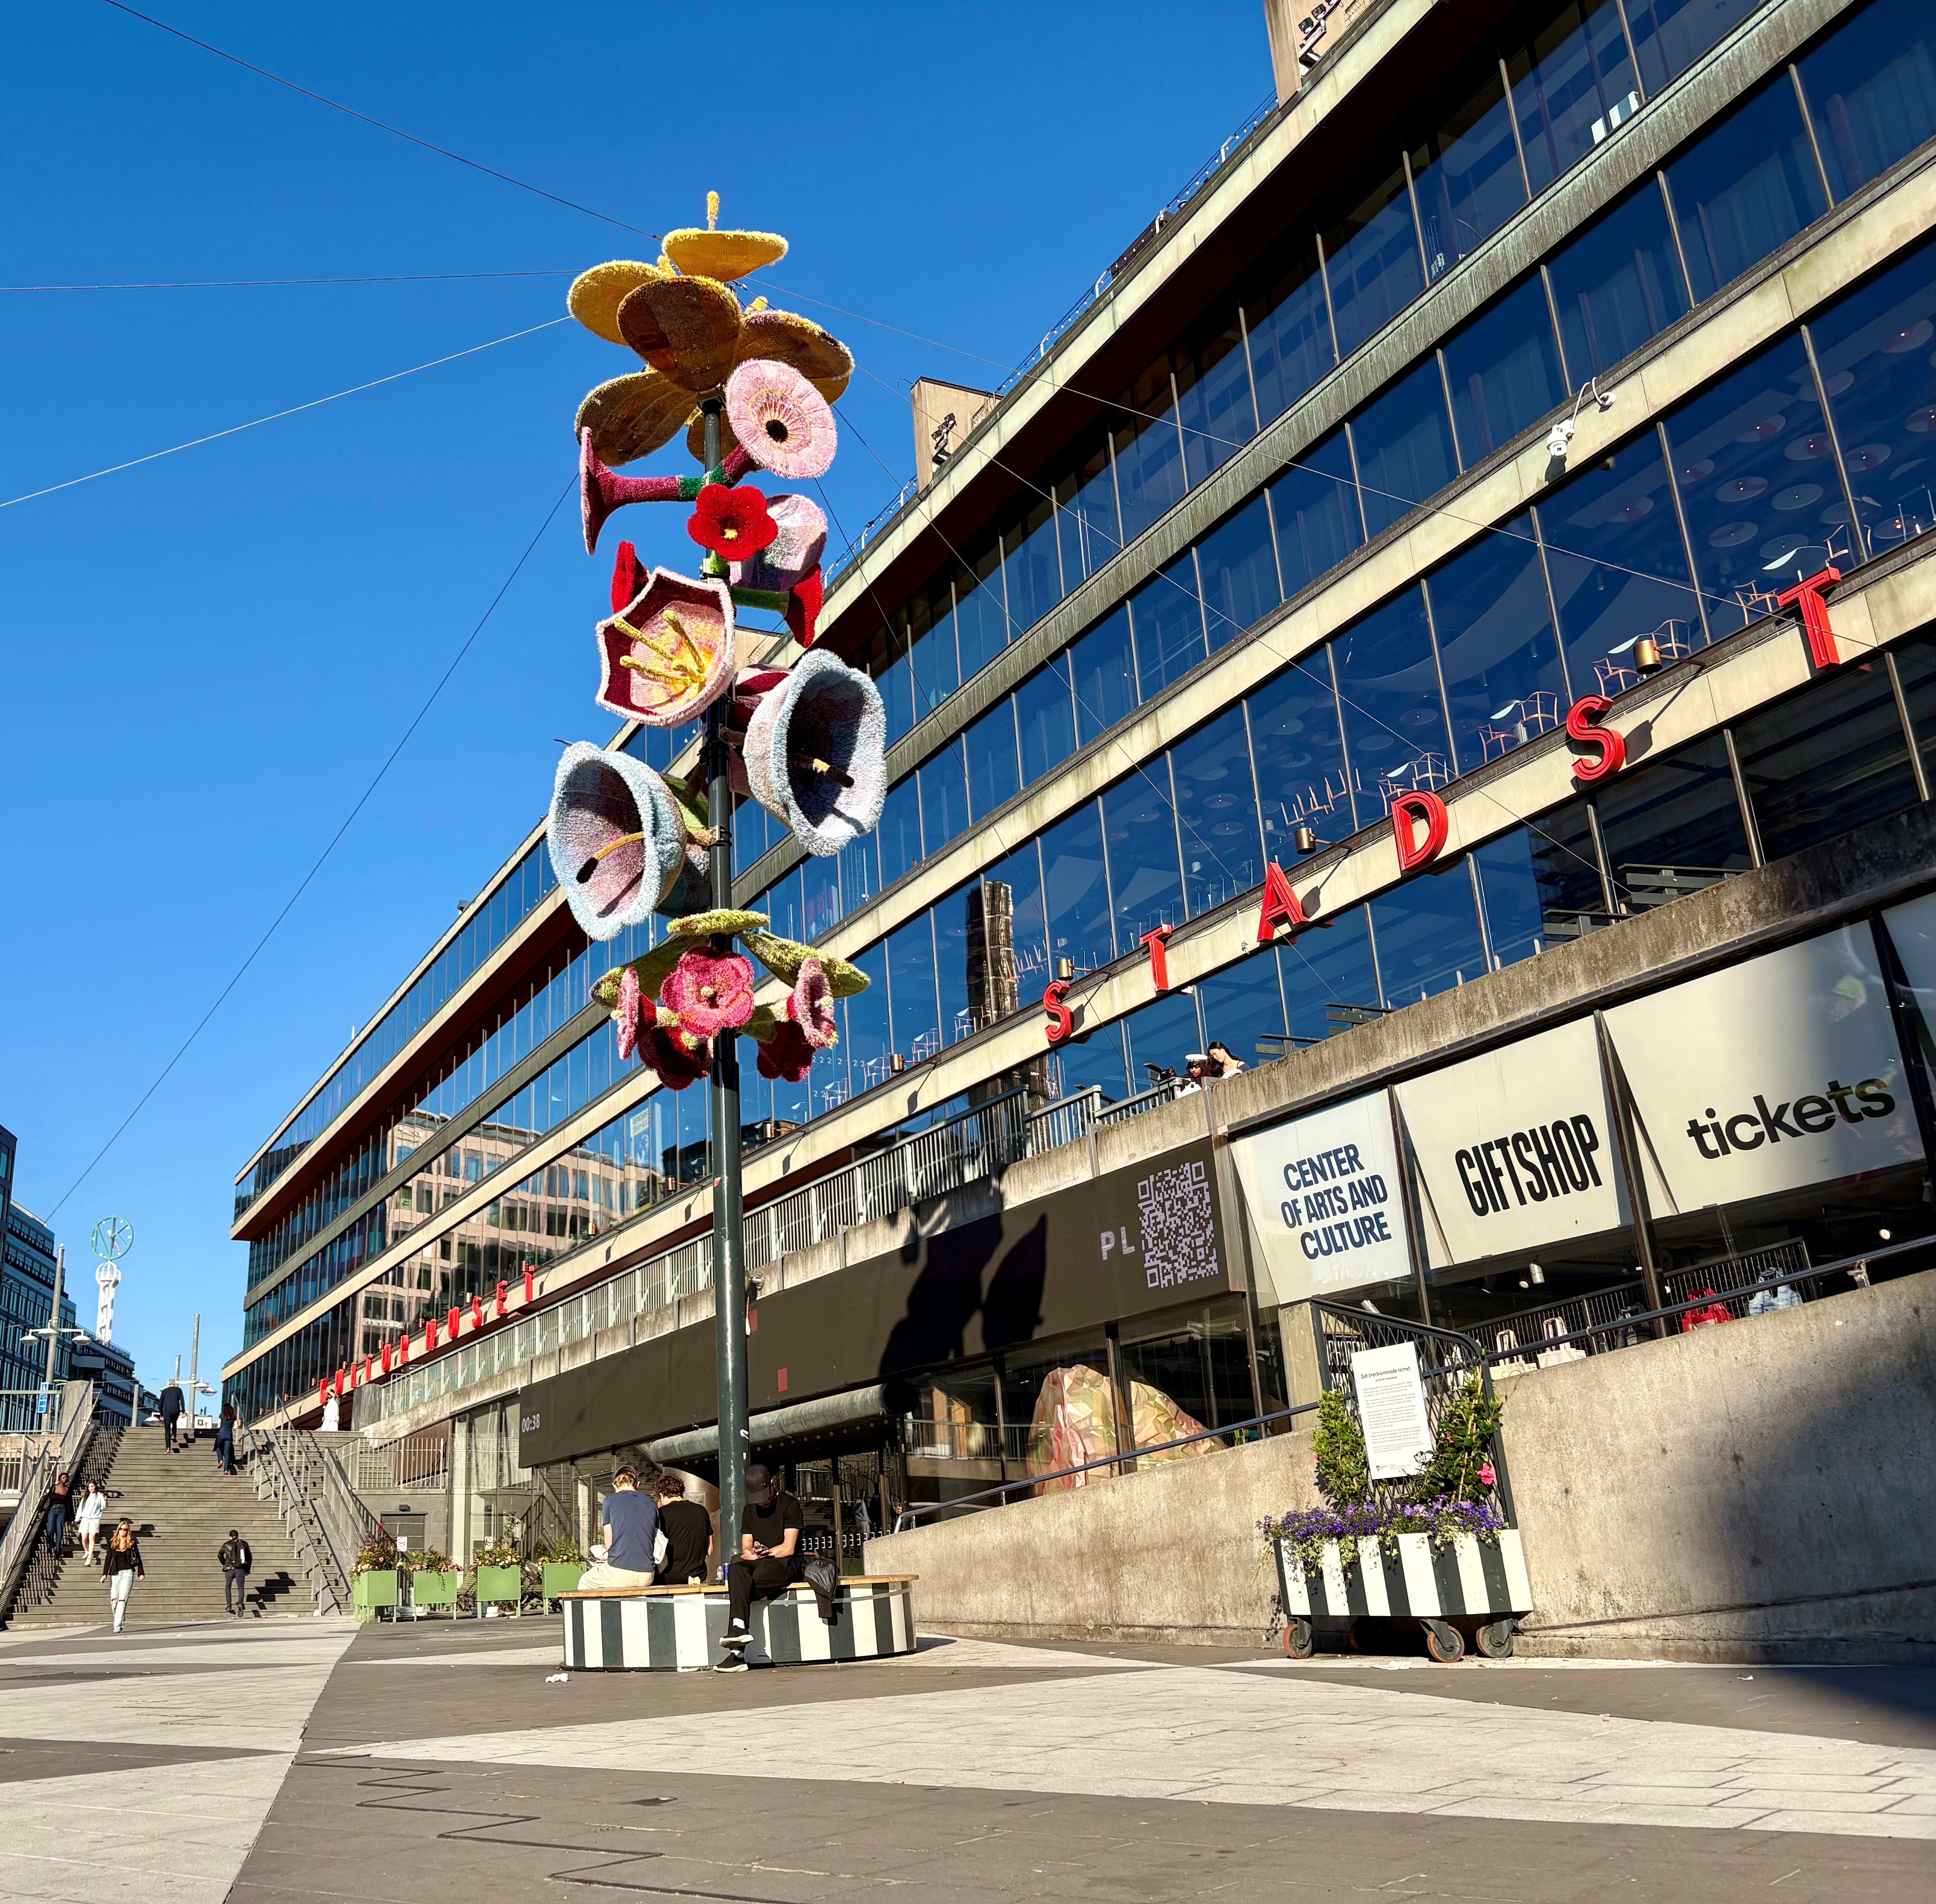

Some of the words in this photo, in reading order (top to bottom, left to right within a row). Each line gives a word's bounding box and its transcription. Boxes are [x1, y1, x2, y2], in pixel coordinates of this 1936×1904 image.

[1686, 1078, 1896, 1159] tickets
[1283, 1144, 1365, 1191] CENTER
[1455, 1114, 1603, 1216] GIFTSHOP
[1281, 1199, 1303, 1228] OF
[1304, 1186, 1348, 1223] ARTS
[1348, 1174, 1388, 1211] AND
[1300, 1211, 1392, 1260] CULTURE
[521, 1413, 541, 1433] 00:38
